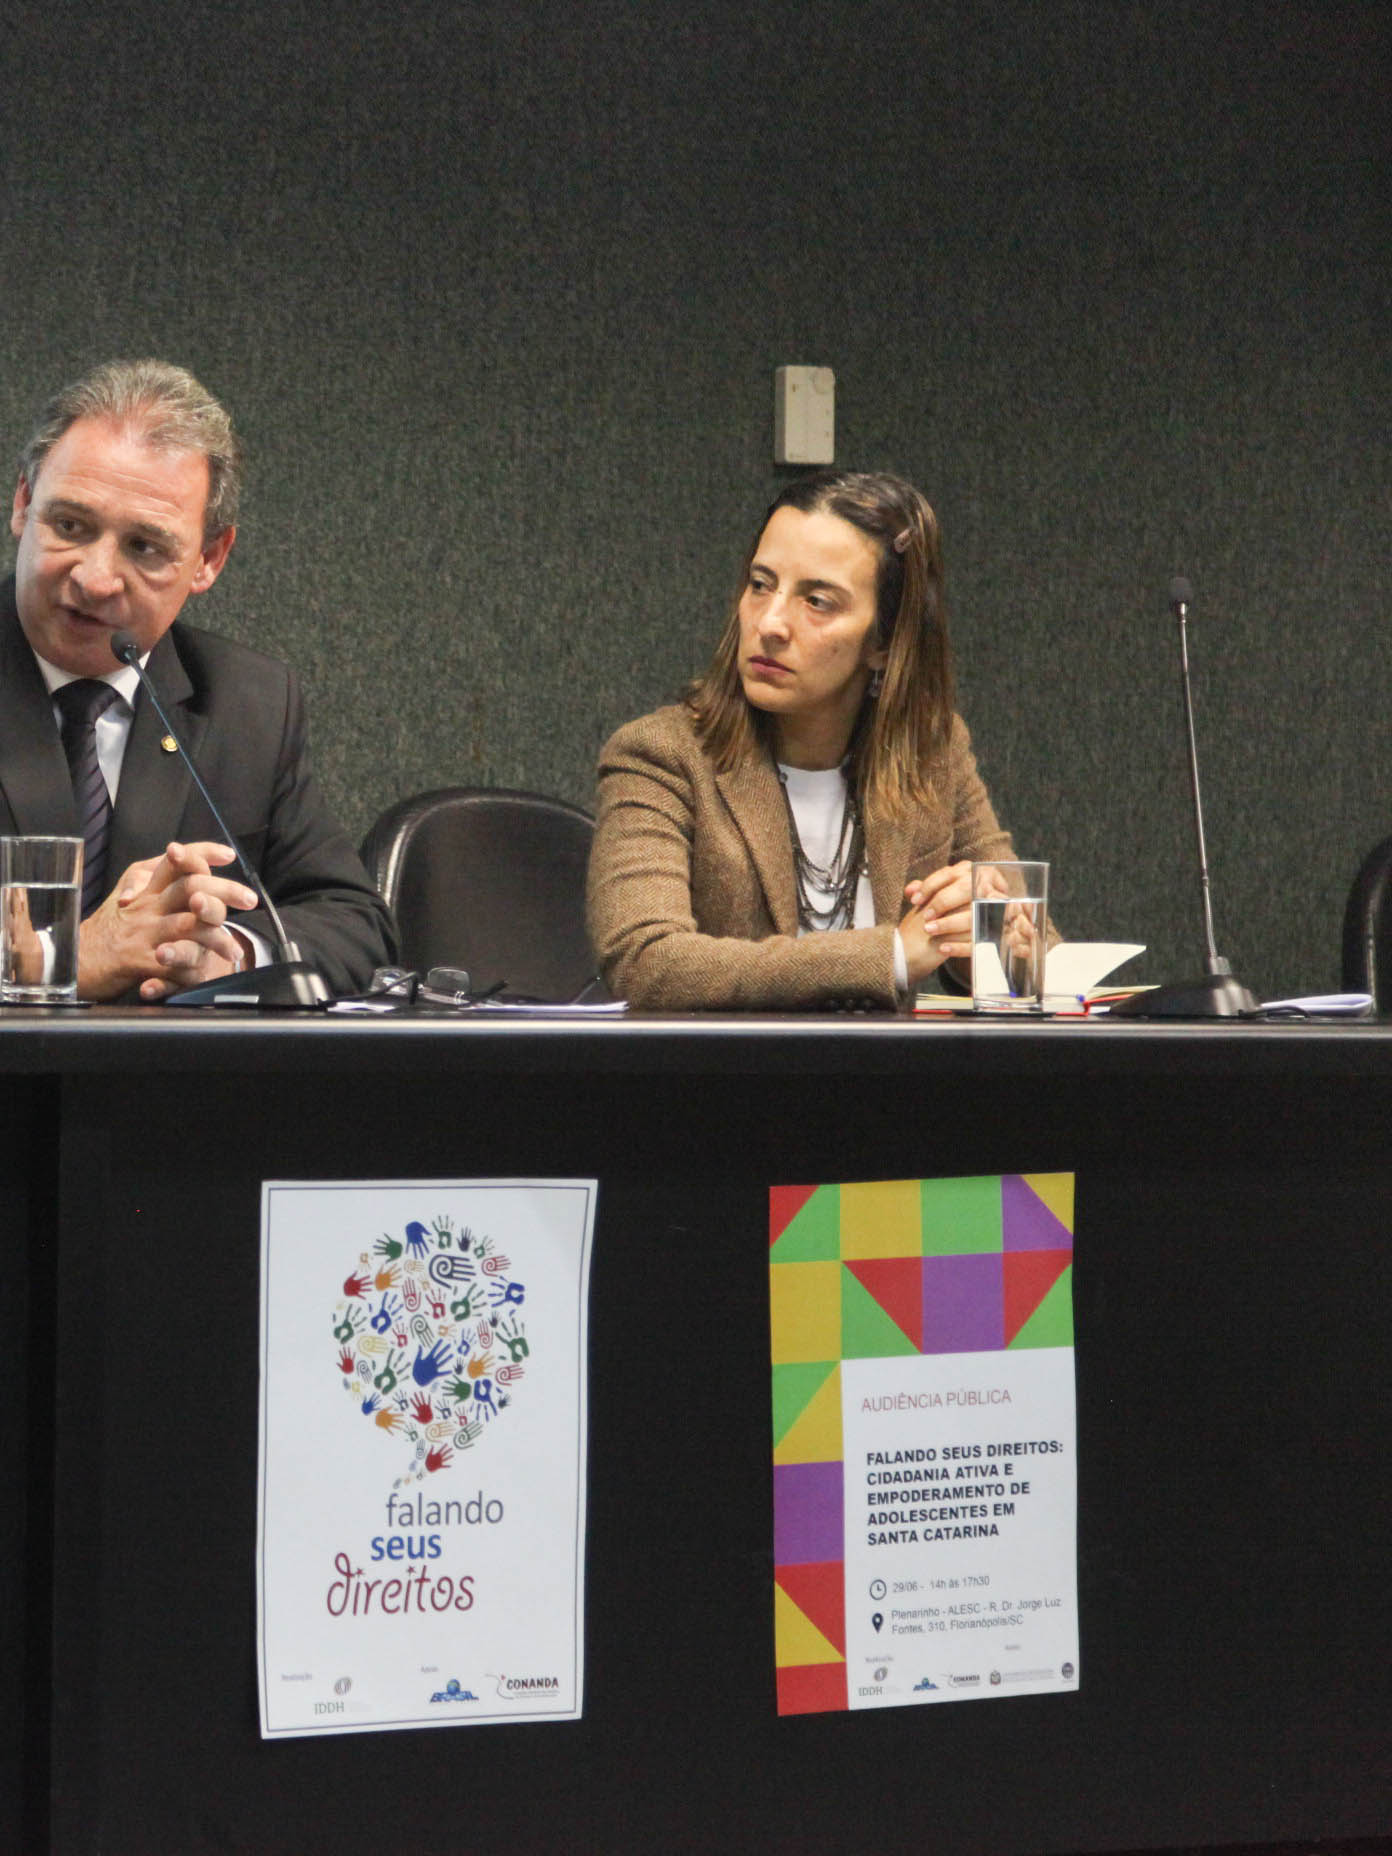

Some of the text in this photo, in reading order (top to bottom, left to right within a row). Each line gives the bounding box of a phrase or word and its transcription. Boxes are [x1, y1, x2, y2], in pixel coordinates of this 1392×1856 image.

[861, 1388, 1012, 1413] AUDIÊNCIA PÚBLICA
[866, 1440, 1064, 1466] FALANDO SEUS DIREITOS:
[867, 1463, 1014, 1486] CIDADANIA ATIVA E
[867, 1482, 1030, 1506] EMPODERAMENTO DE
[386, 1491, 504, 1527] falando
[867, 1502, 1015, 1526] ADOLESCENTES EM
[867, 1523, 999, 1546] SANTA CATARINA
[371, 1533, 442, 1561] seus
[326, 1552, 474, 1616] direitos
[892, 1581, 918, 1593] 29/06
[930, 1579, 946, 1590] 14h
[963, 1575, 991, 1588] 17h30
[891, 1607, 941, 1620] Plenarinho
[948, 1602, 981, 1616] ALESC
[1017, 1598, 1042, 1612] Jorge
[1045, 1597, 1062, 1608] Luz
[506, 1677, 559, 1690] CONANDA
[314, 1701, 345, 1715] IDDH
